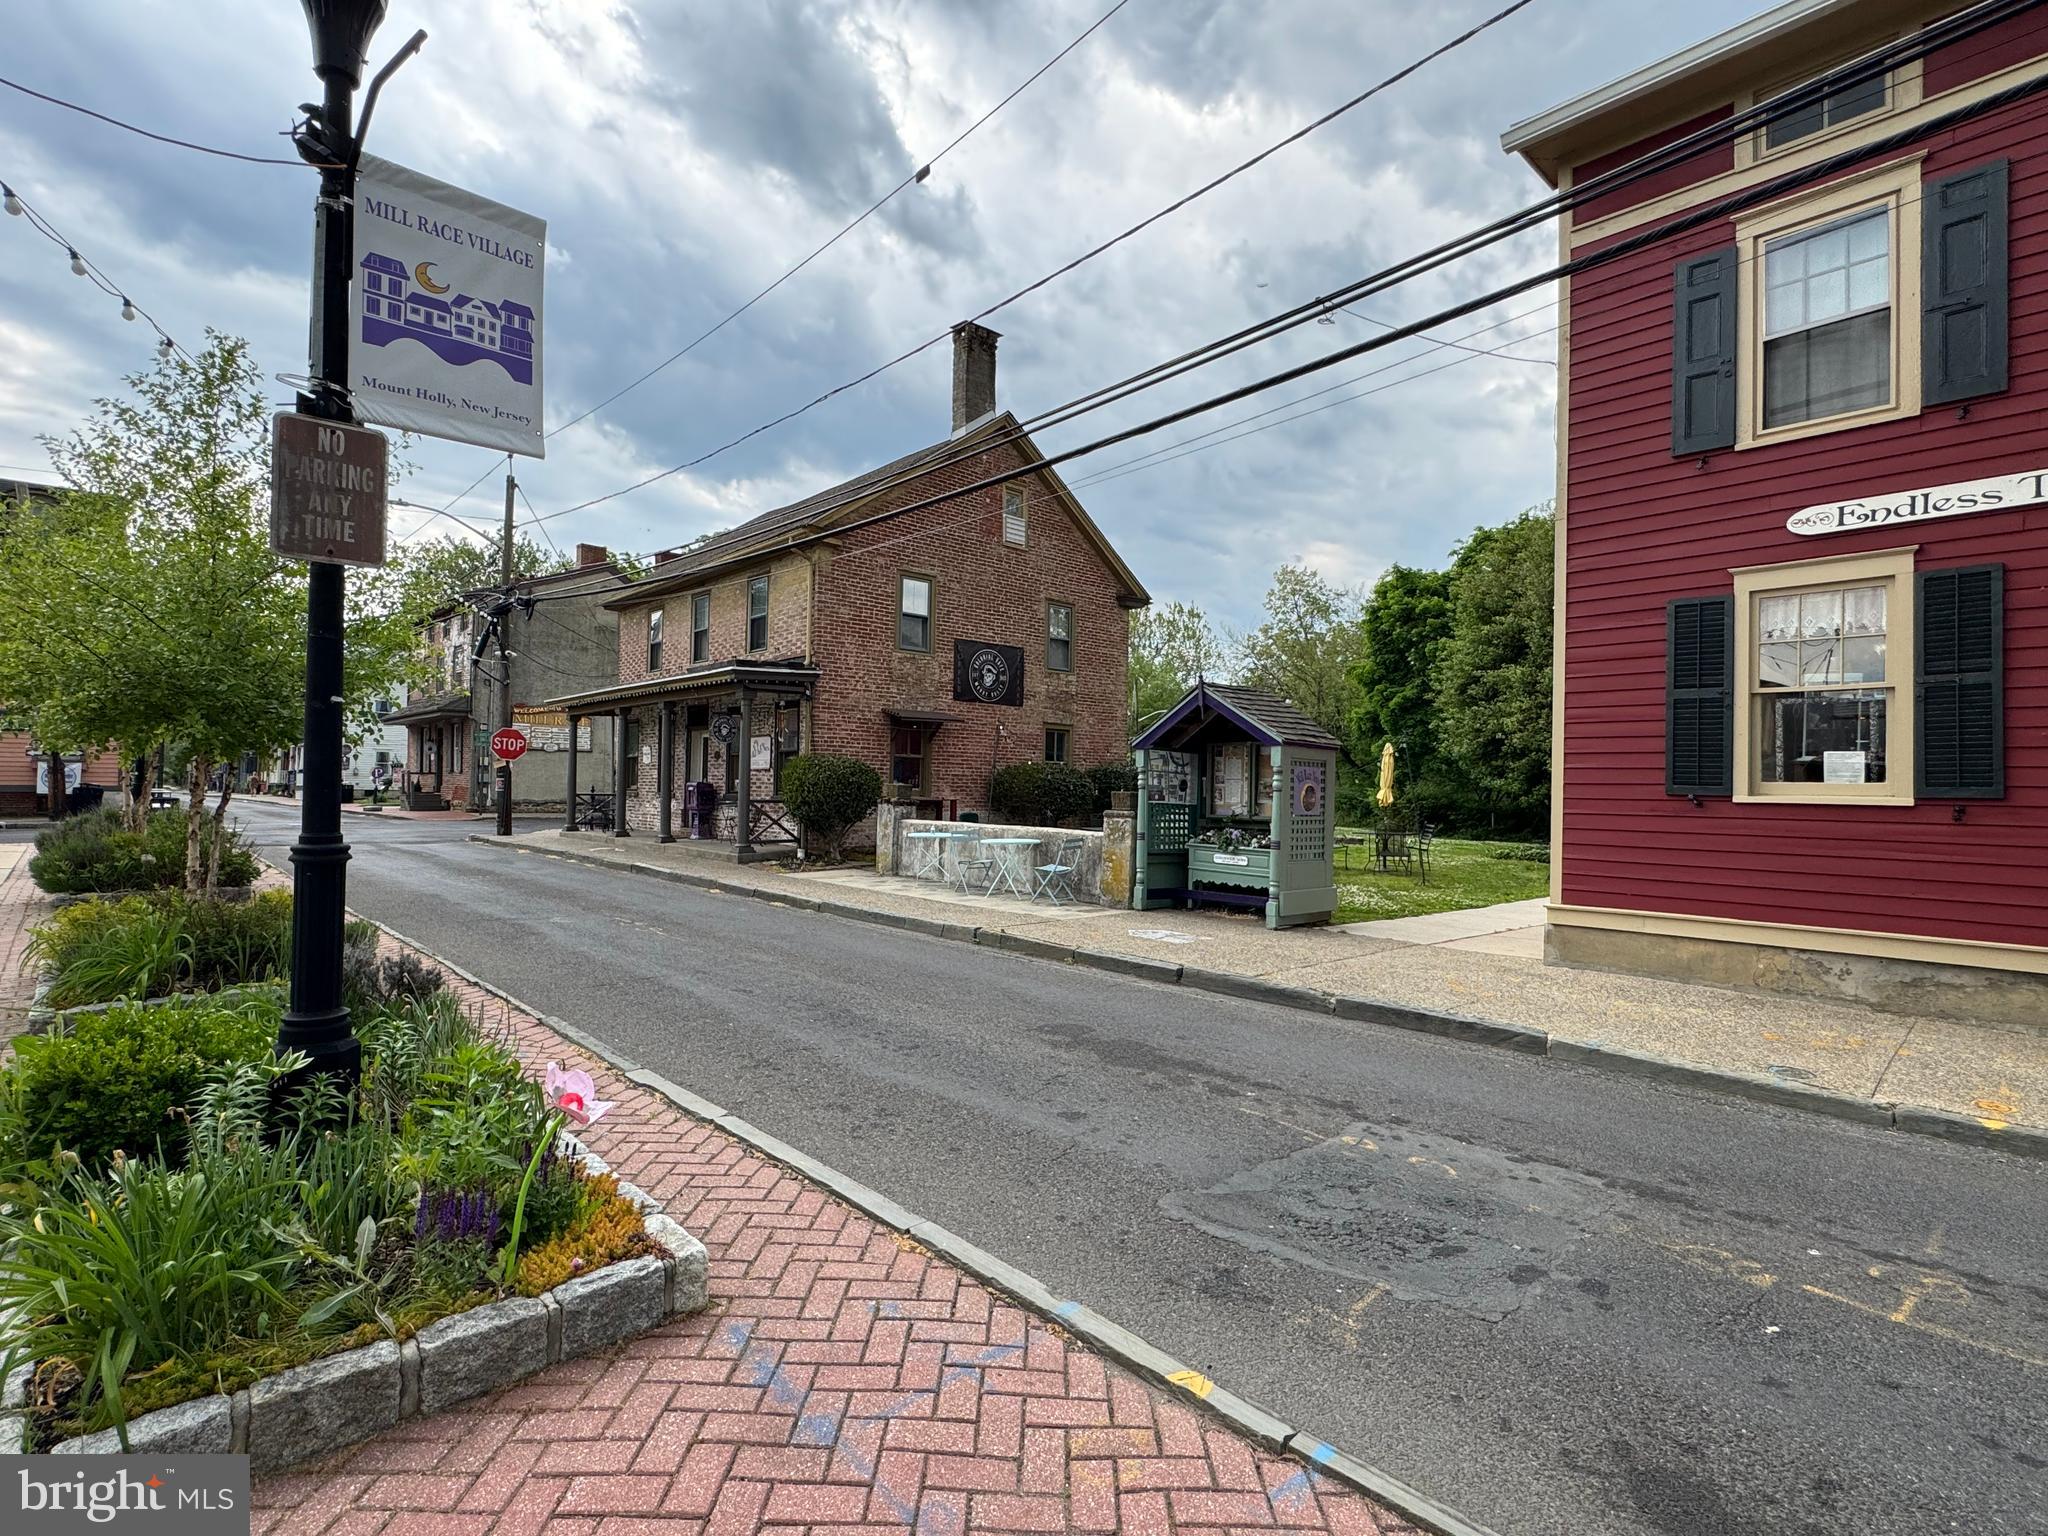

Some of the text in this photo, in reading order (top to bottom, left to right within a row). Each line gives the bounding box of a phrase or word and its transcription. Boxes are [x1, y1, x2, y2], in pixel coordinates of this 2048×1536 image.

[365, 197, 534, 269] MILL RACE VILLAGE
[362, 376, 533, 426] Mount Holly, New Jersey
[318, 426, 345, 456] NO
[308, 490, 352, 516] ANY
[1836, 492, 2003, 528] Endless
[302, 514, 355, 543] TIME
[493, 737, 525, 751] STOP
